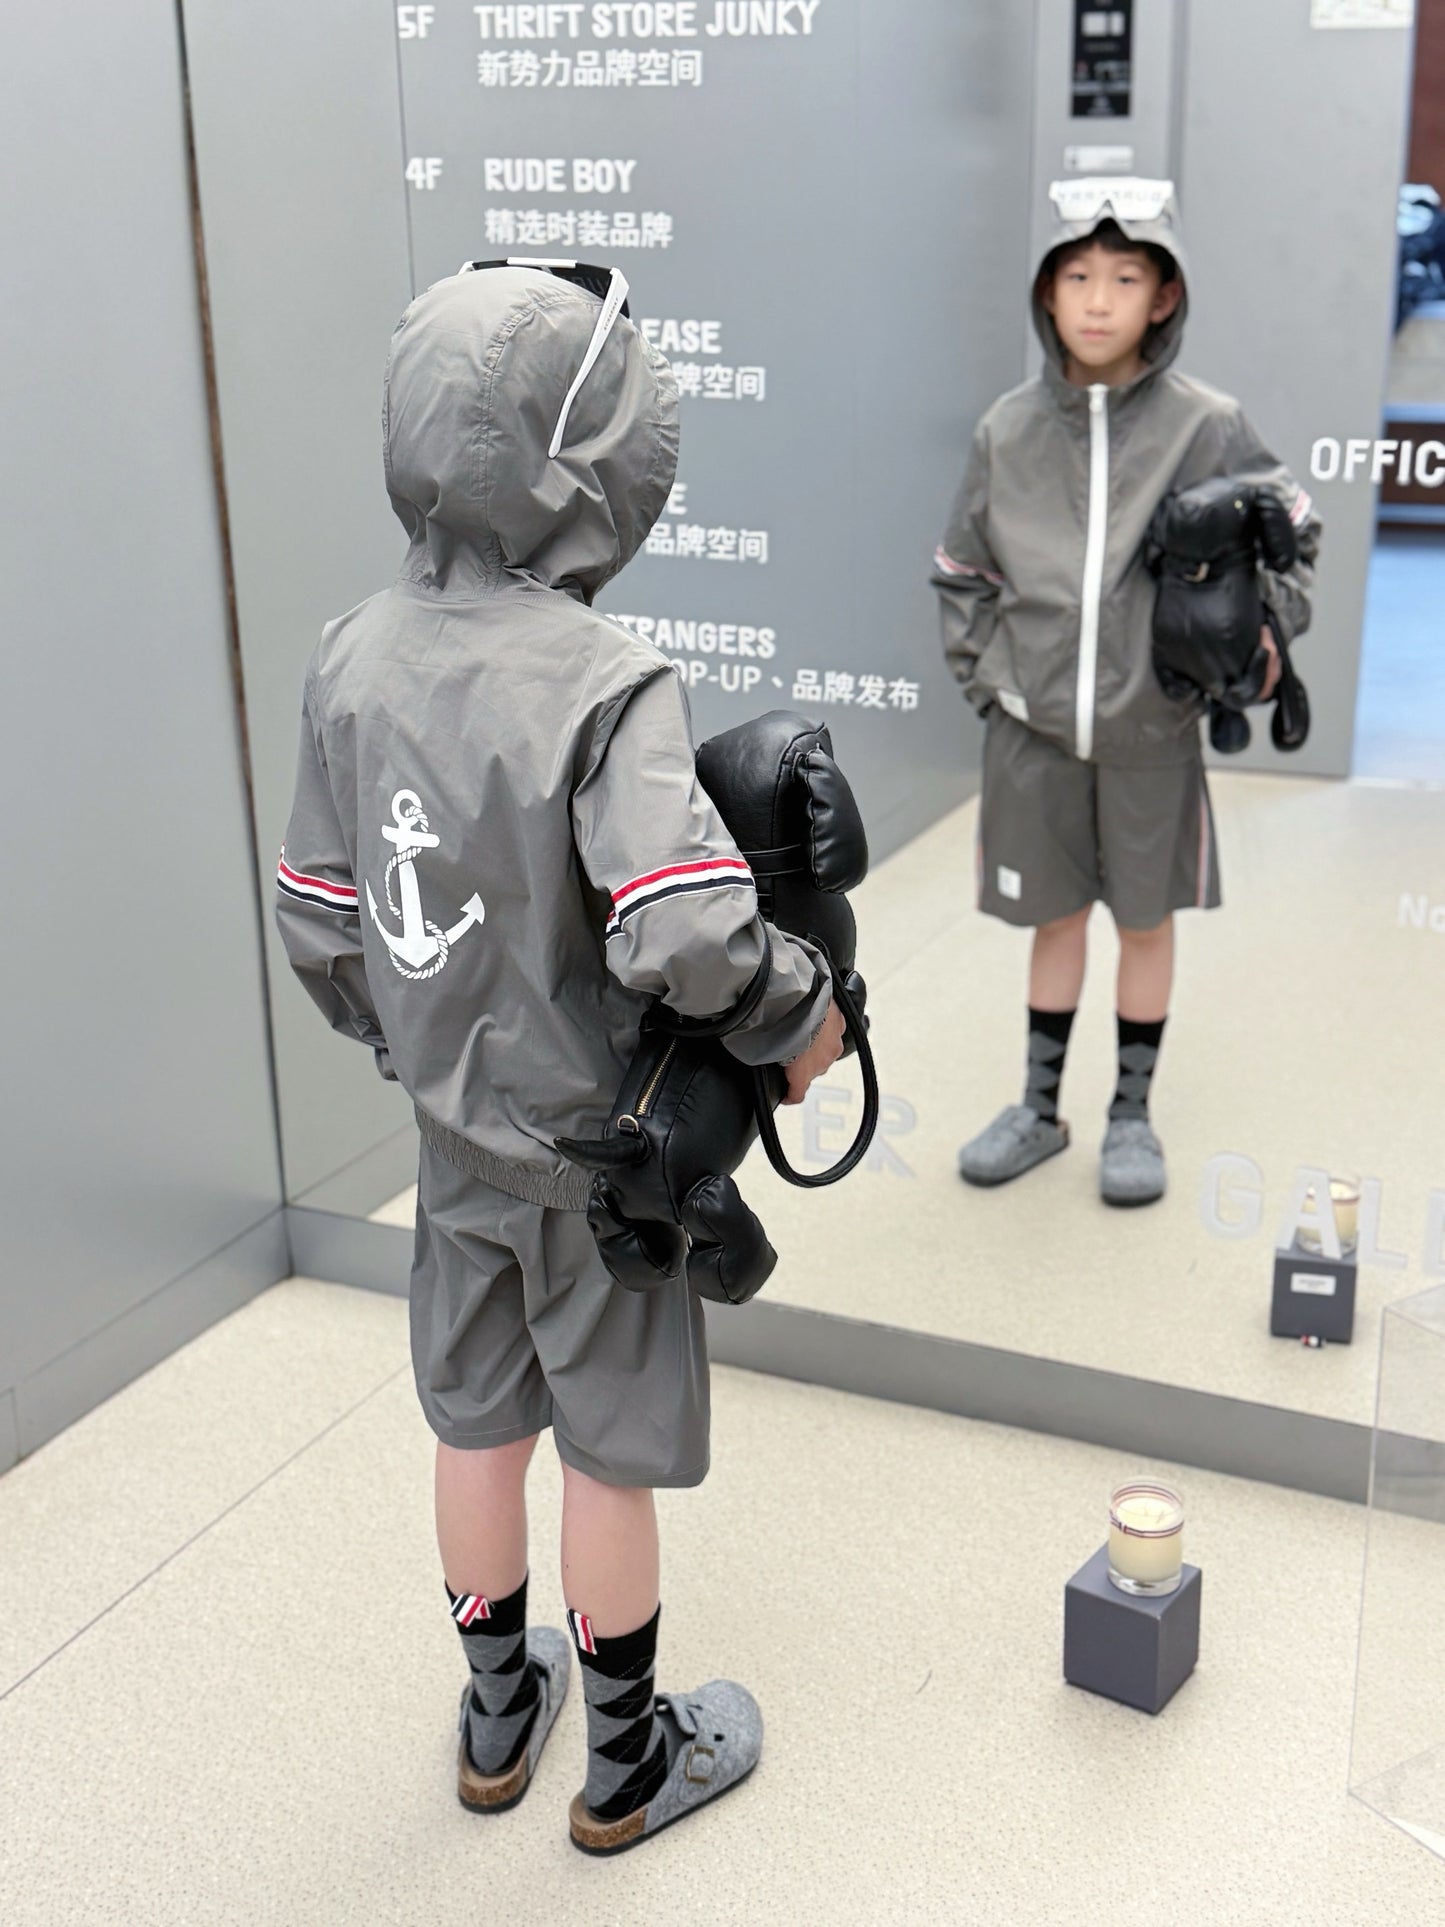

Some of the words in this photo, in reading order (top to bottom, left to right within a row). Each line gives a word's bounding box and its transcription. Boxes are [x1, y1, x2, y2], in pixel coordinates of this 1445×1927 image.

[397, 5, 435, 39] 5F
[473, 4, 585, 39] THRIFT
[591, 1, 698, 38] STORE
[705, 0, 820, 37] JUNKY
[477, 49, 703, 87] 新势力品牌空间
[405, 157, 444, 190] 4F
[484, 158, 567, 192] RUDE
[572, 158, 637, 194] BOY
[484, 208, 674, 249] 精选时装品牌
[1310, 437, 1445, 488] OFFIC
[604, 613, 777, 659] RANGERS
